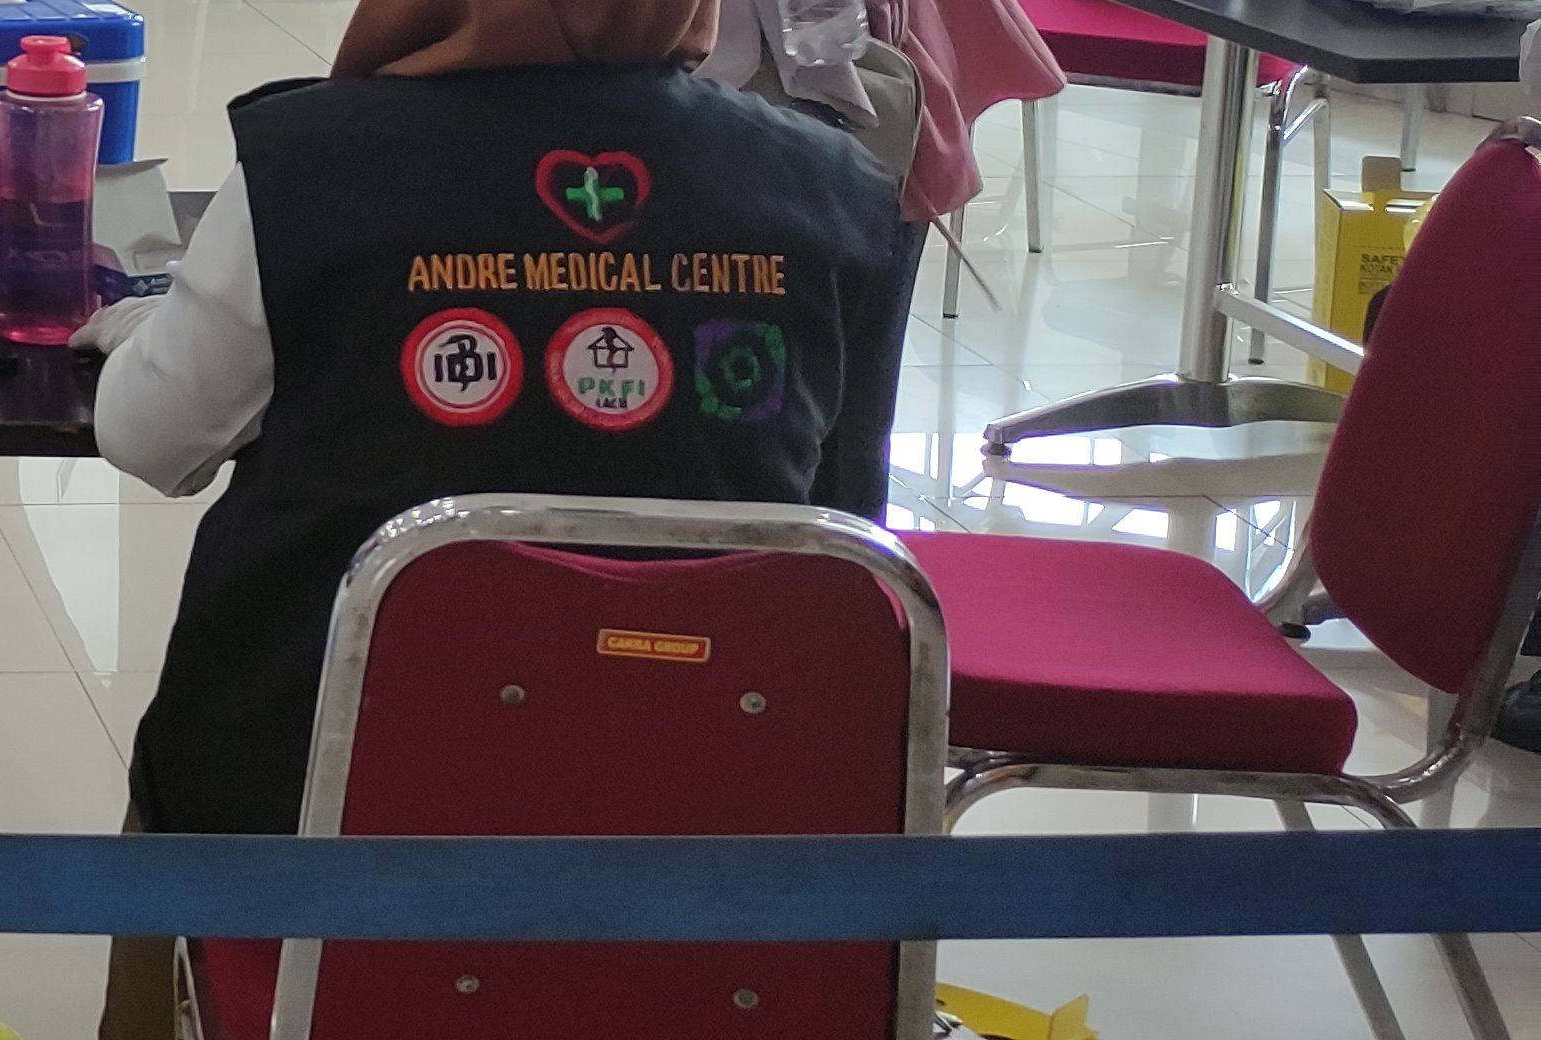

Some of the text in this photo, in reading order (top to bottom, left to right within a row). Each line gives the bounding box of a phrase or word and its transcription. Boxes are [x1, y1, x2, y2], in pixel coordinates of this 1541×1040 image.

[408, 252, 786, 295] ANDRE MEDICAL CENTRE
[578, 377, 646, 397] PKFI
